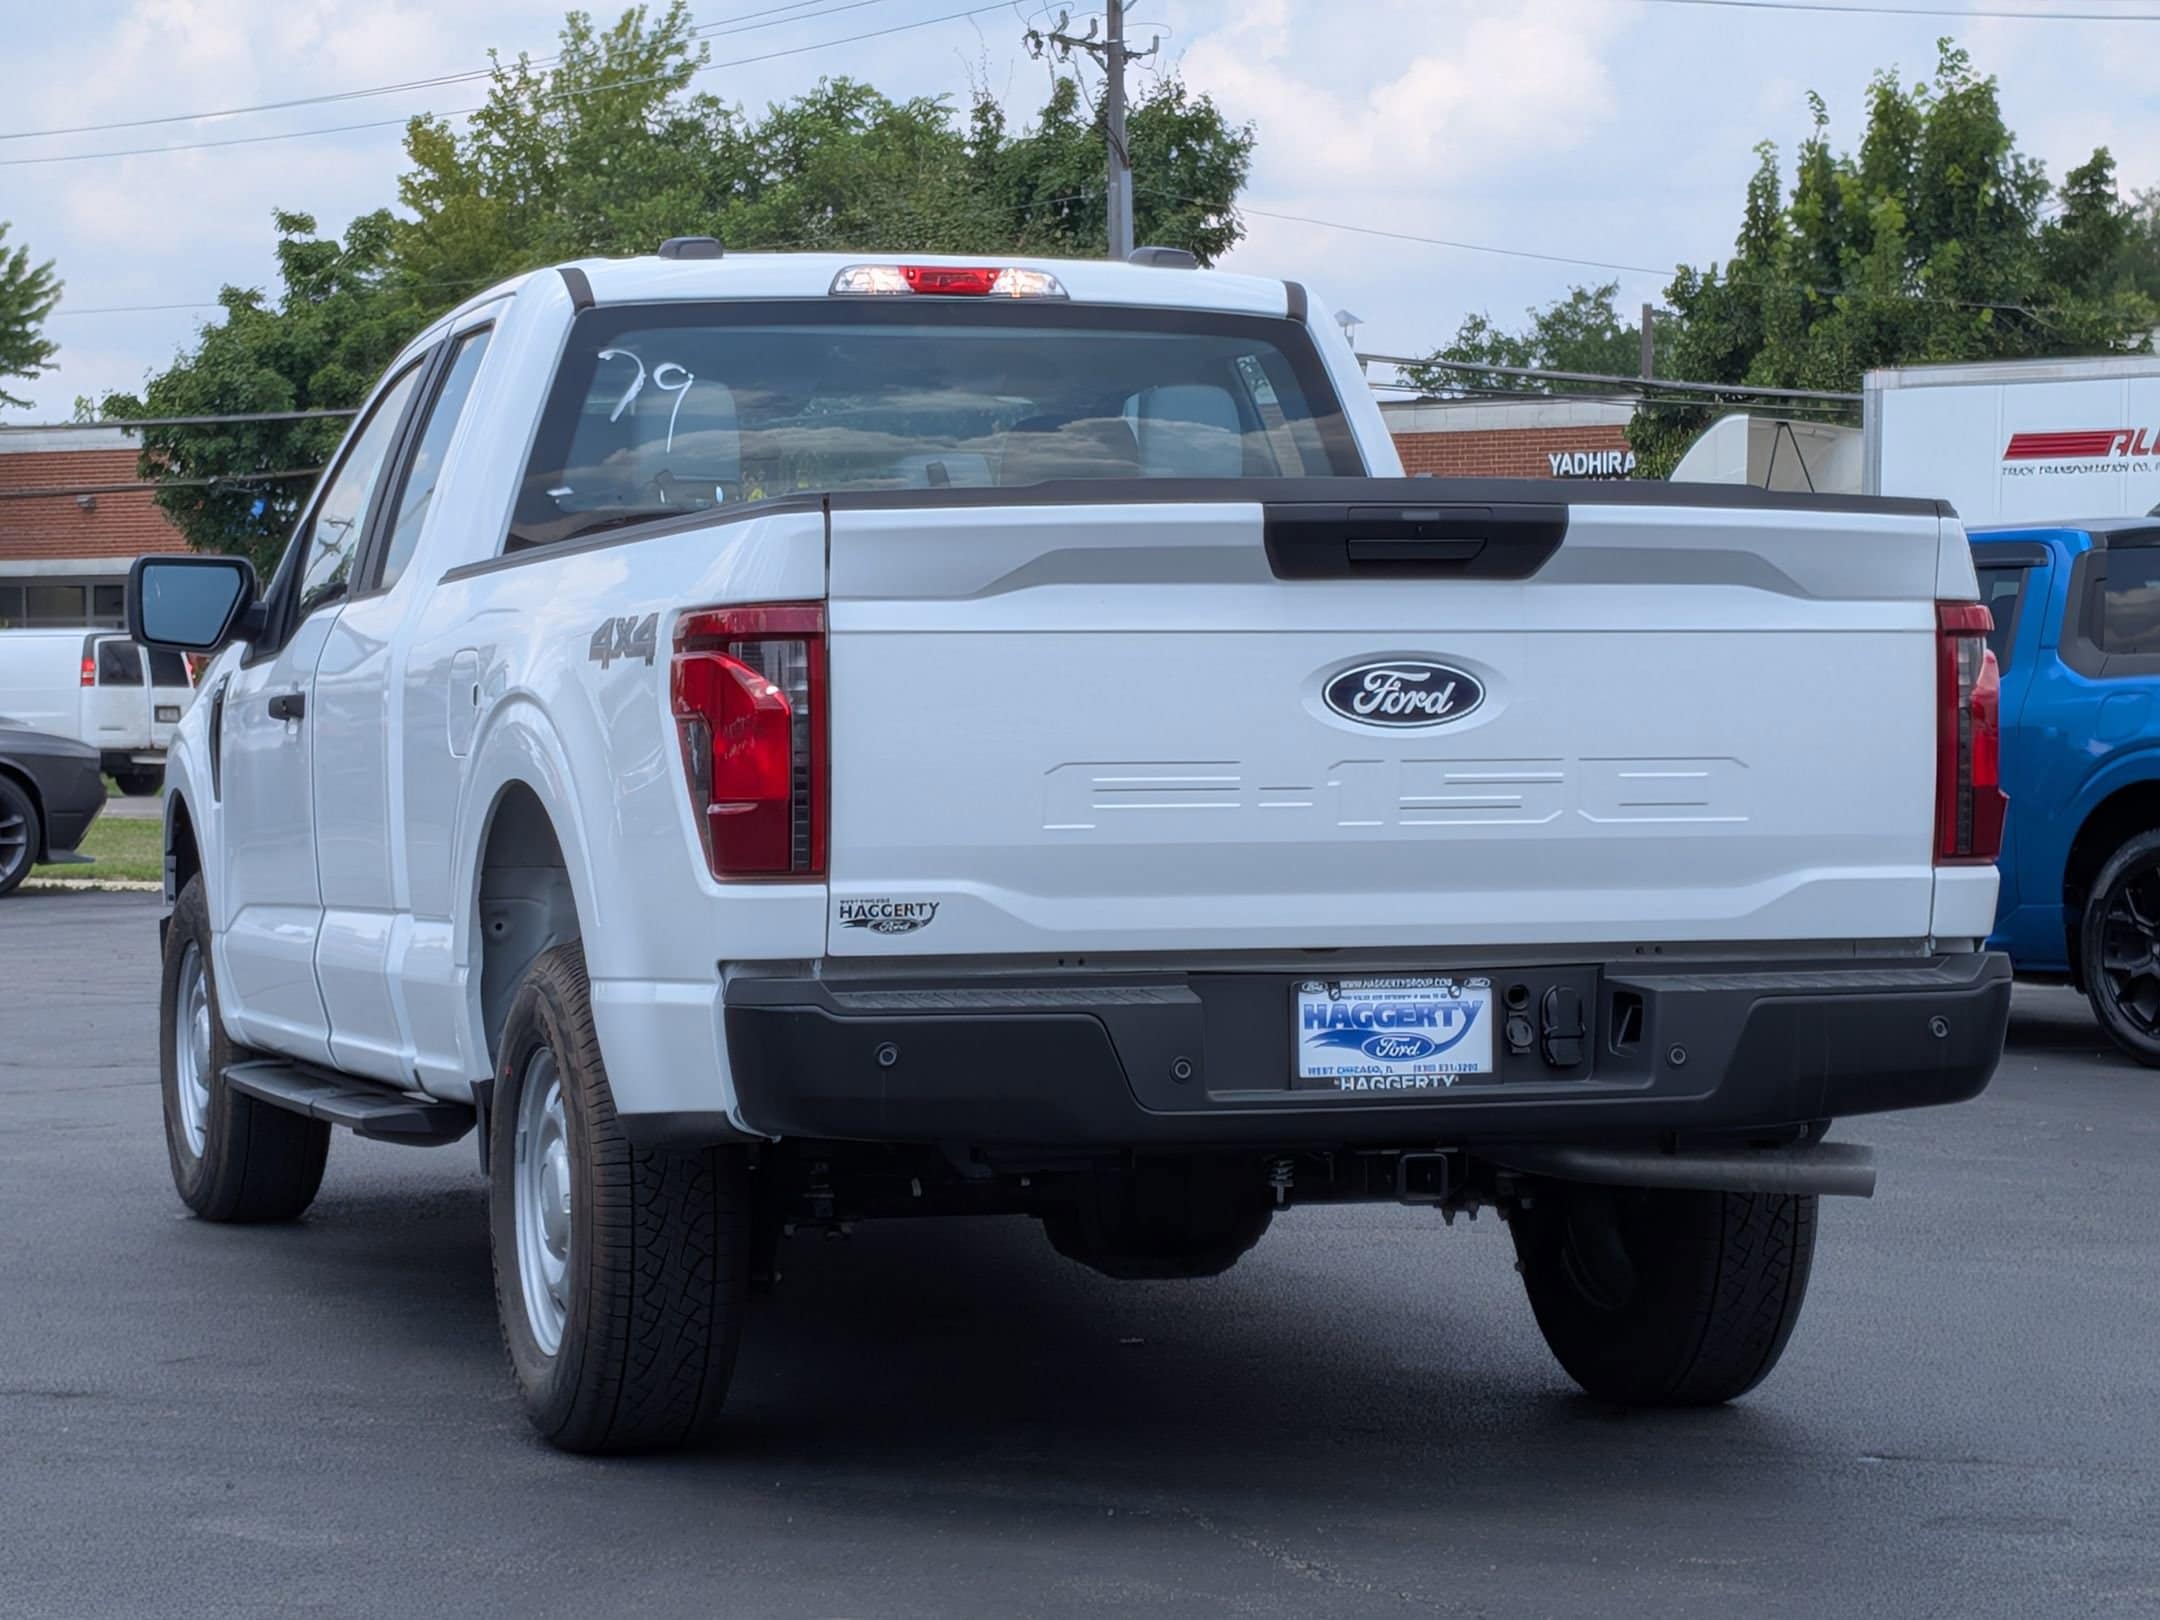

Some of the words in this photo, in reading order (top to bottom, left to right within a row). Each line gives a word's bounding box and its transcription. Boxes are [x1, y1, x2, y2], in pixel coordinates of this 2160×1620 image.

[1548, 451, 1636, 476] YADHIRA
[1353, 670, 1456, 714] Ford
[839, 902, 940, 920] HAGGERTY
[1303, 1000, 1484, 1030] HAGGERTY
[1375, 1037, 1420, 1057] Ford
[1340, 1075, 1455, 1091] HAGGERTY
